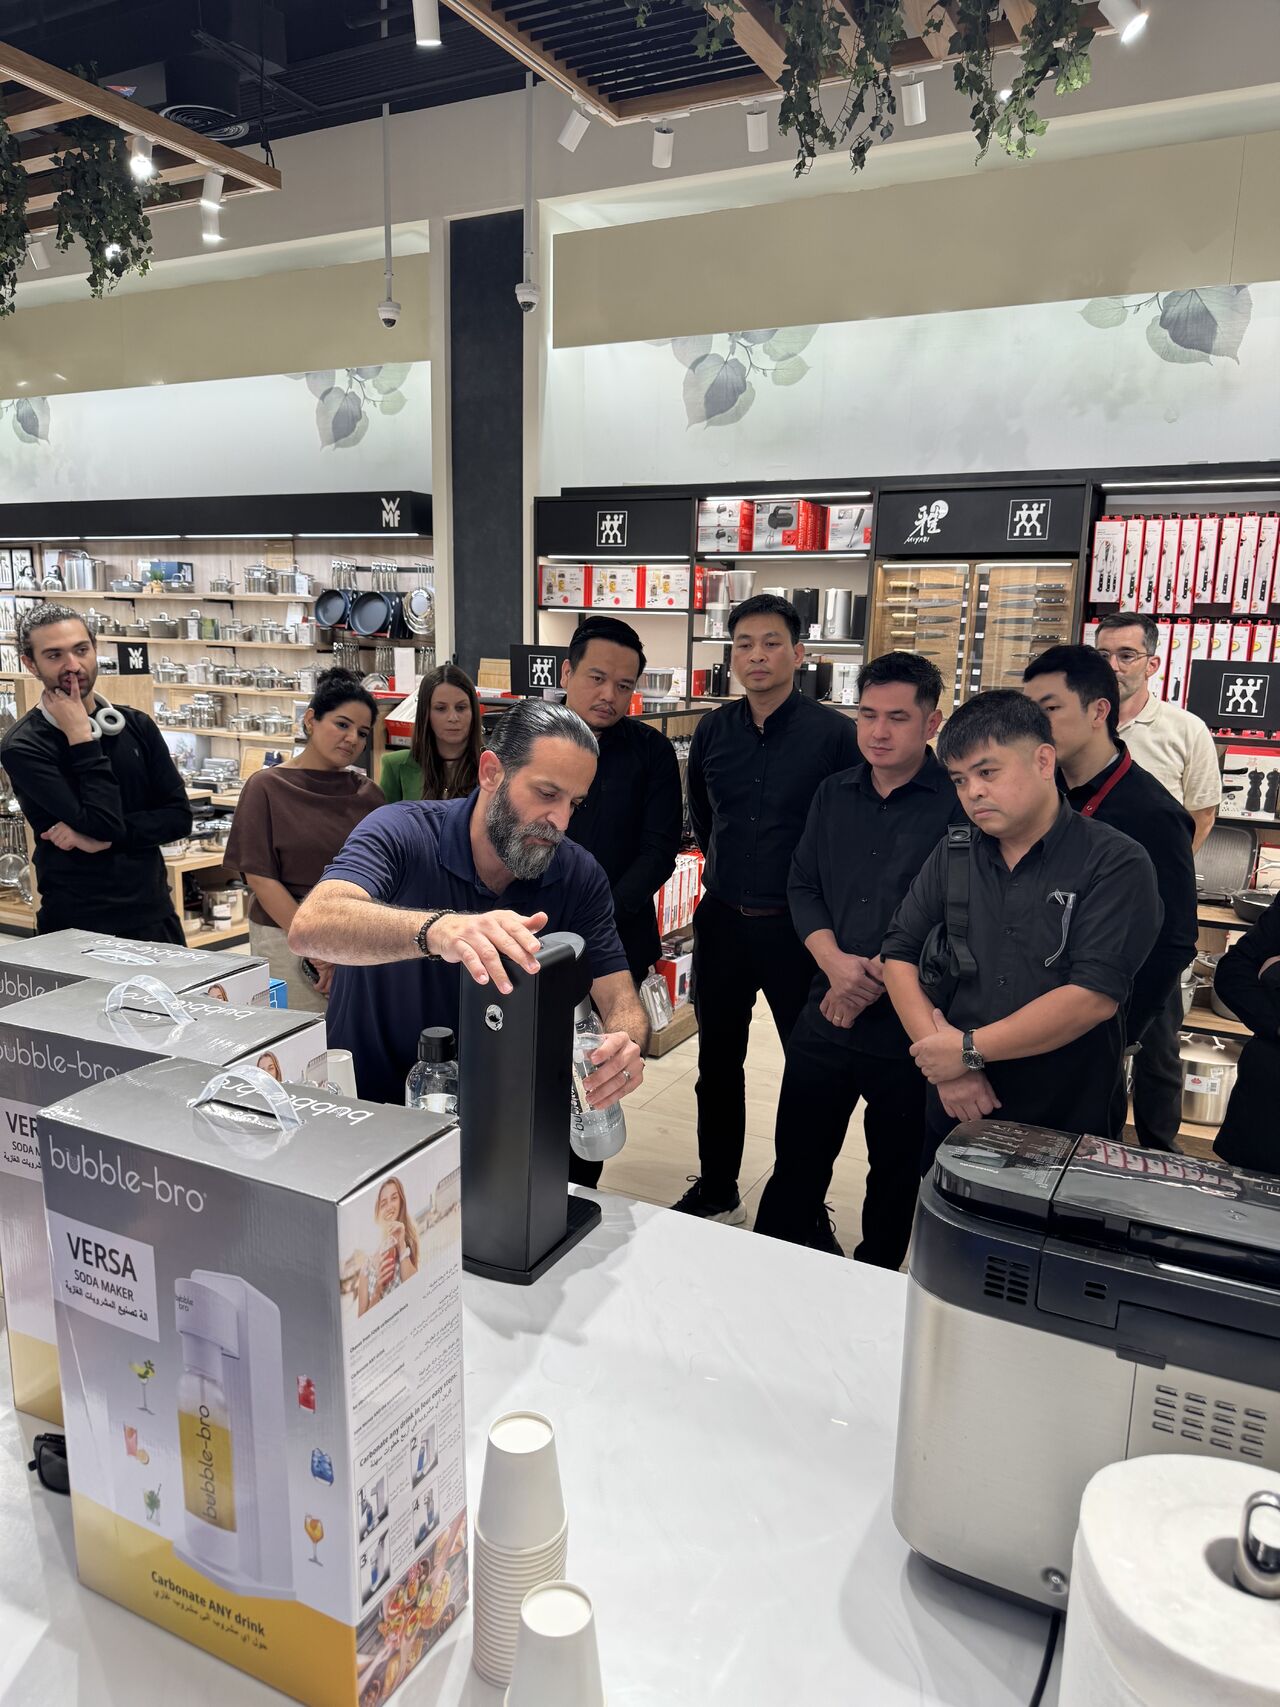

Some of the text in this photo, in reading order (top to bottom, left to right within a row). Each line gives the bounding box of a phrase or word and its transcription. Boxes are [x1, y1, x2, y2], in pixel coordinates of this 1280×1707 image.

[5, 1111, 39, 1138] VER
[12, 1141, 34, 1155] SODA
[49, 1134, 205, 1213] bubble-bro
[66, 1231, 138, 1282] VERSA
[74, 1269, 135, 1302] SODA MAKER
[360, 1436, 389, 1467] Carbonate
[389, 1426, 400, 1440] any
[400, 1412, 415, 1429] drink
[411, 1436, 418, 1451] 2
[195, 1404, 217, 1521] bubble-bro
[413, 1497, 419, 1512] 4
[360, 1553, 368, 1569] 3
[151, 1570, 266, 1637] Carbonate ANY drink
